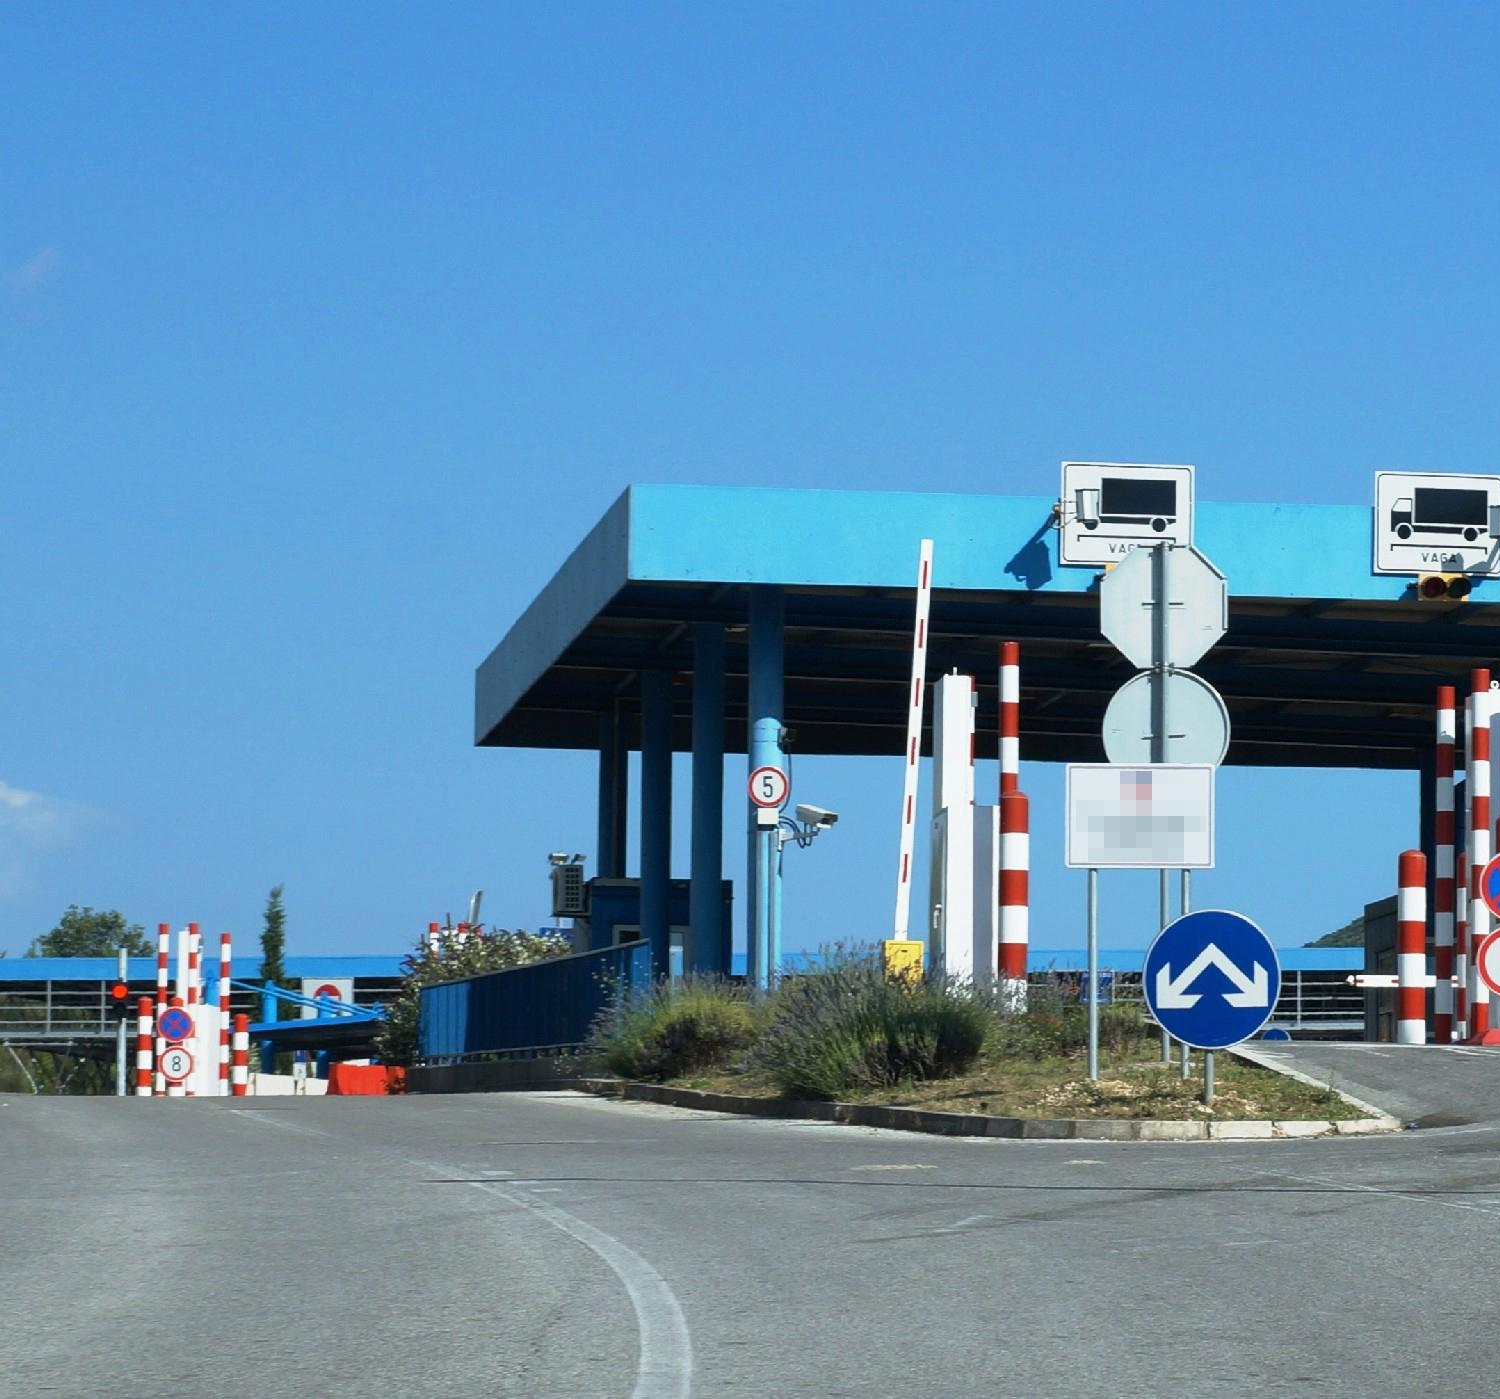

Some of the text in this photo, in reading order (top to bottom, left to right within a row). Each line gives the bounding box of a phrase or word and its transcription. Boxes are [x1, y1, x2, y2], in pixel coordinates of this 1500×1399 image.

[1421, 552, 1458, 563] VAGA
[763, 775, 773, 798] 5
[172, 1055, 181, 1072] 8
